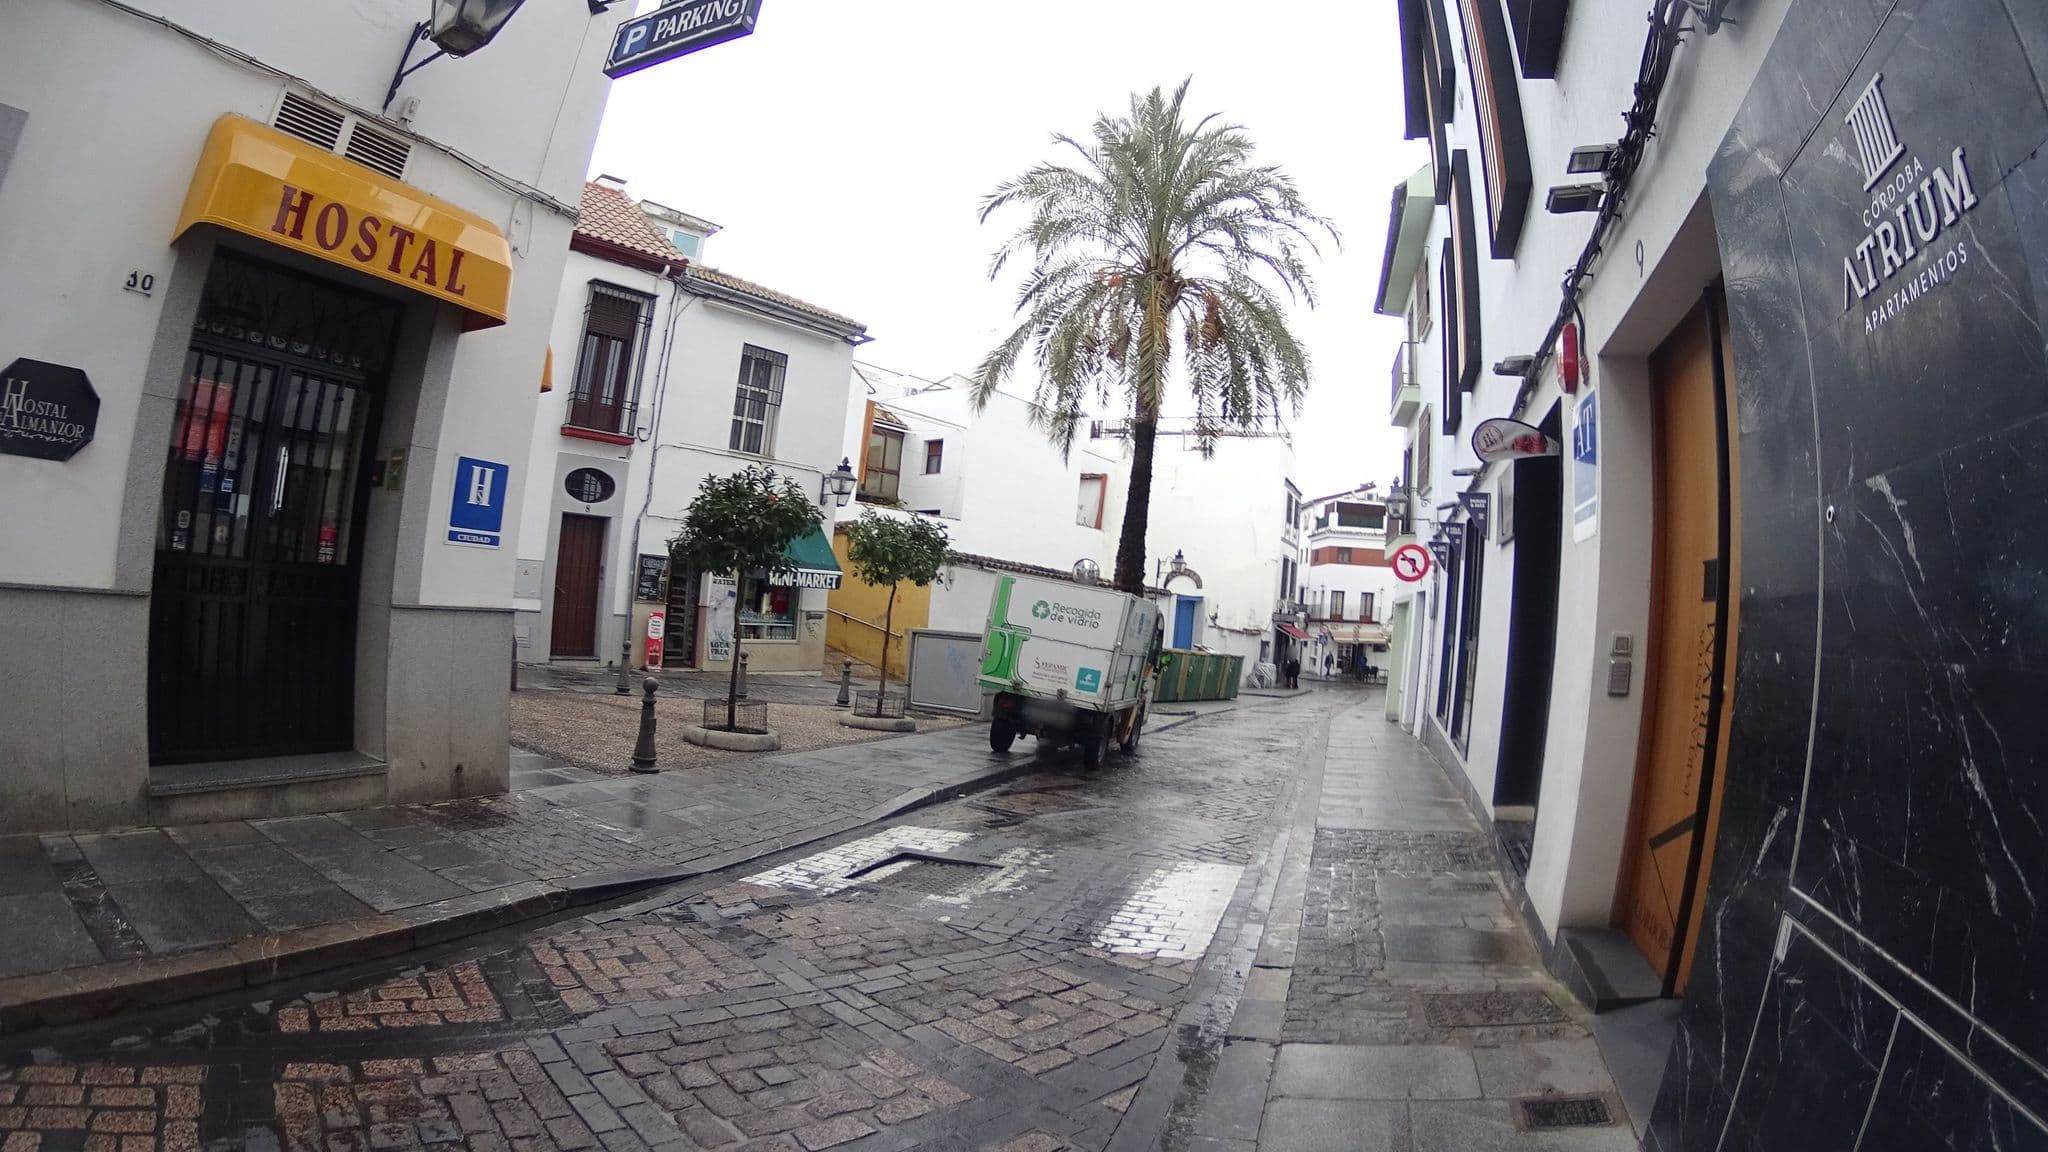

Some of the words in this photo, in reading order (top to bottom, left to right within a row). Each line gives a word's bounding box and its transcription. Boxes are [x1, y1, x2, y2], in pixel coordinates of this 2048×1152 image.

[622, 25, 647, 54] P
[652, 0, 741, 42] PARKING
[1862, 156, 1924, 228] CÓRDOBA
[271, 184, 467, 297] HOSTAL
[1635, 239, 1644, 278] 9
[1864, 242, 1968, 335] APARTAMENTOS
[1, 378, 69, 419] HOSTAL
[457, 534, 491, 544] CIUDAD
[1050, 611, 1065, 623] de
[1067, 615, 1100, 629] vidrio
[1052, 602, 1101, 620] Recogida
